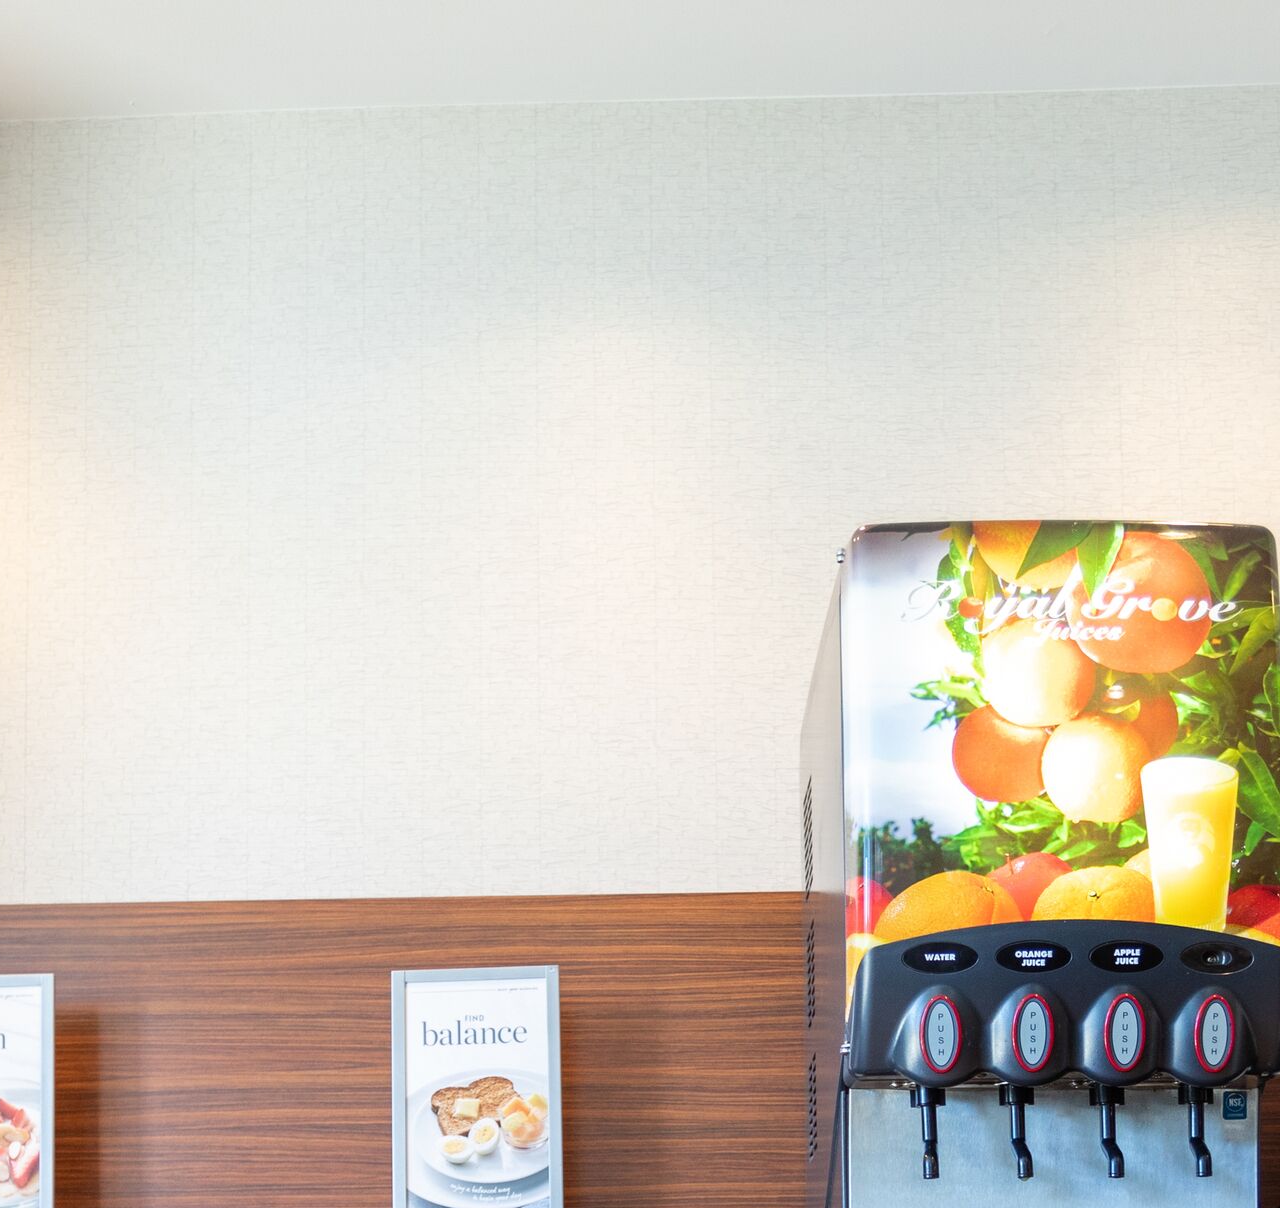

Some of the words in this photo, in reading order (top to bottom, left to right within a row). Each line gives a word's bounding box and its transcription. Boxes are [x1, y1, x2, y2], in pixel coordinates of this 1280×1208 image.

[1031, 617, 1125, 642] Juices
[1014, 950, 1053, 959] ORANGE
[1113, 948, 1141, 957] APPLE
[924, 953, 956, 962] WATER
[1115, 957, 1139, 965] JUICE
[1021, 959, 1046, 967] JUICE
[464, 1014, 485, 1022] FIND
[422, 1020, 528, 1047] balance
[937, 1012, 945, 1056] PUSH
[1121, 1011, 1129, 1055] PUSH
[1211, 1012, 1219, 1055] PUSH
[1228, 1097, 1242, 1107] NSF
